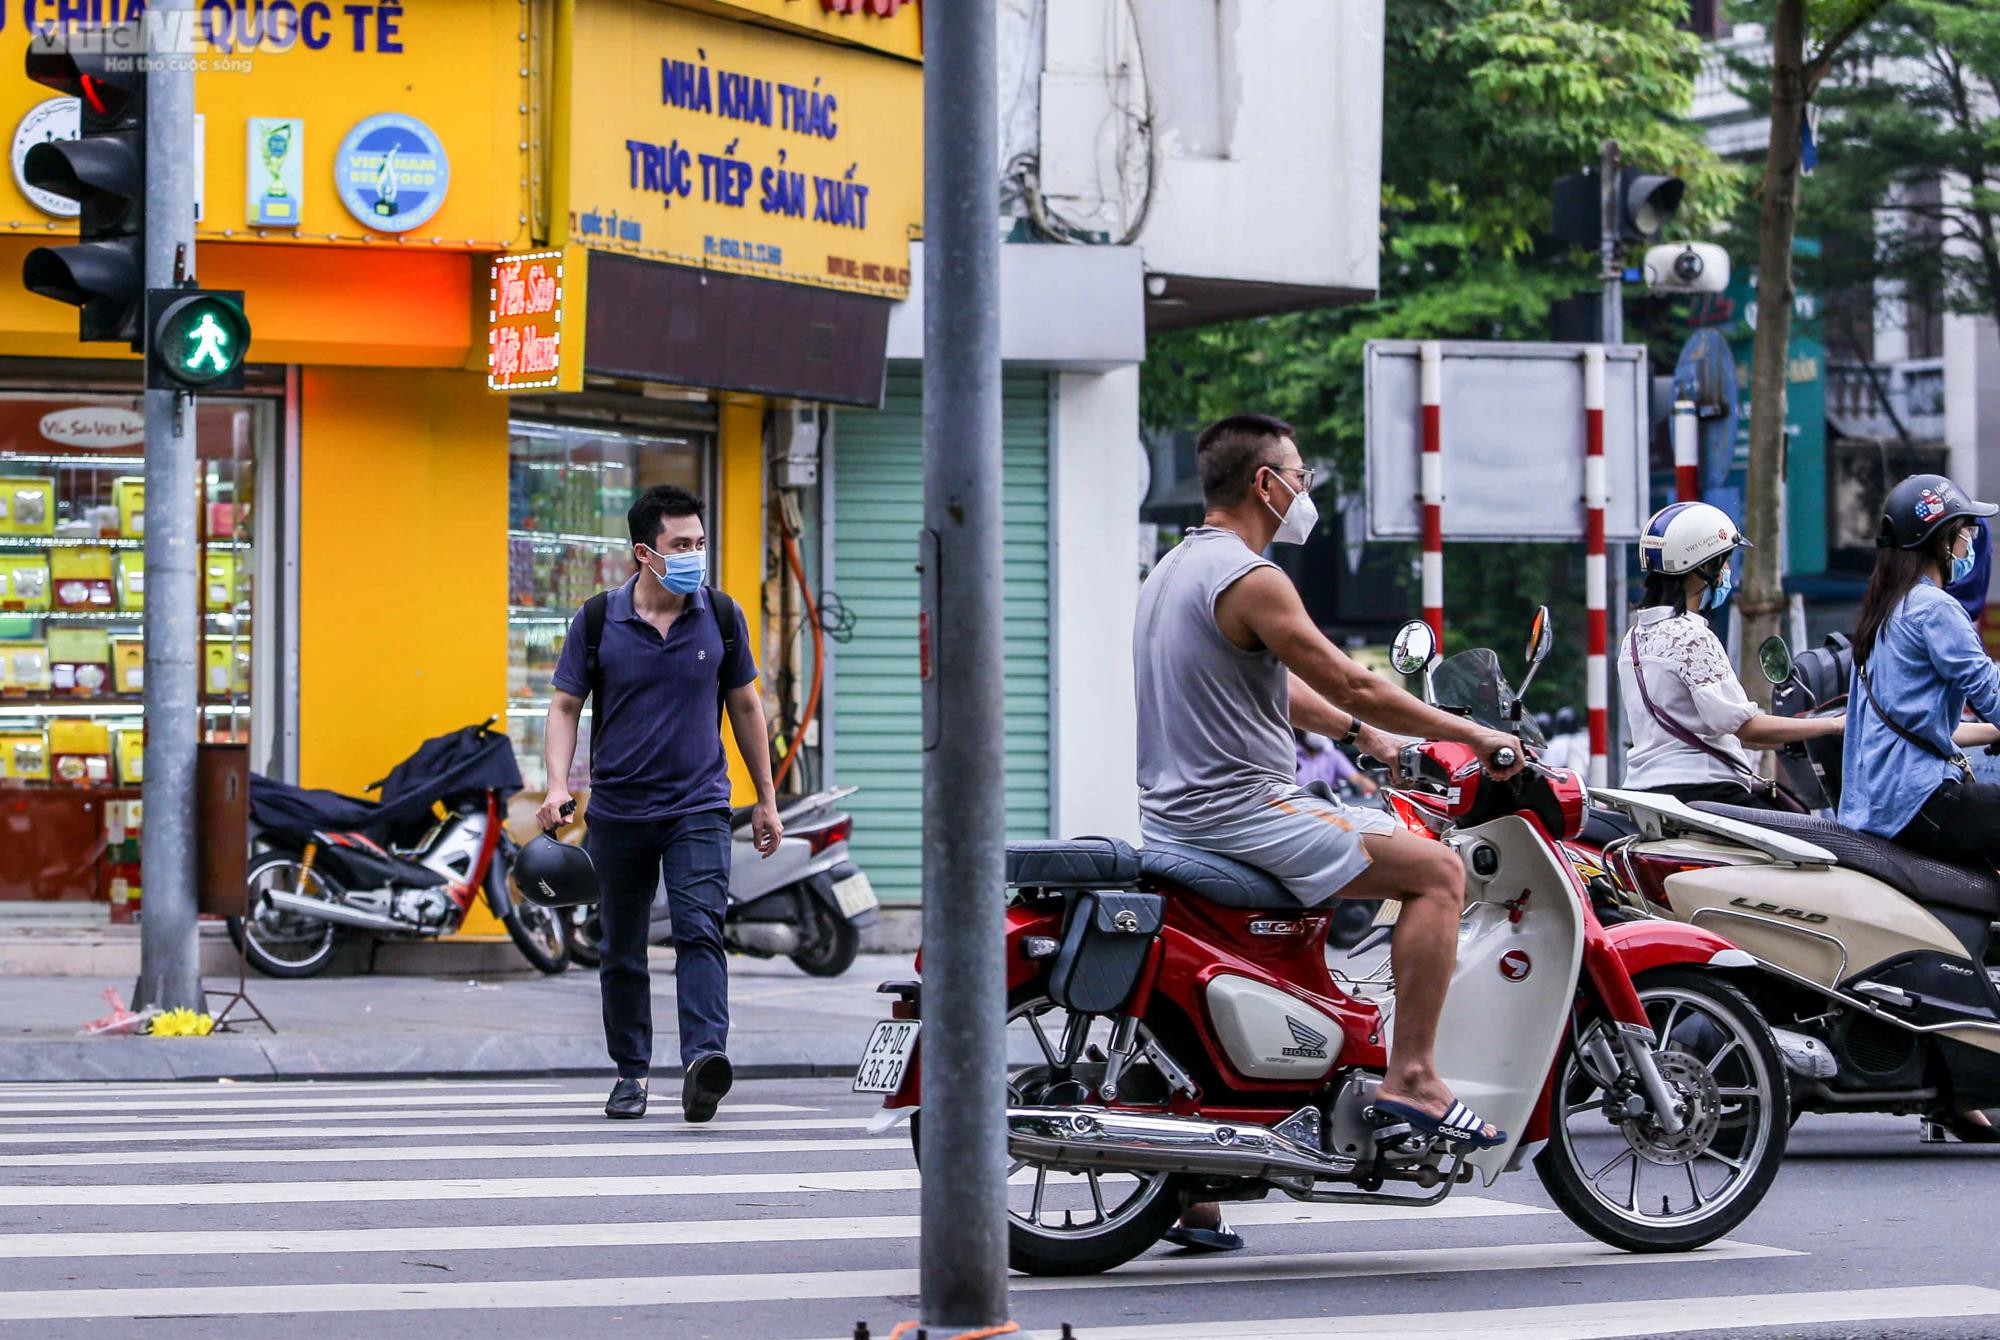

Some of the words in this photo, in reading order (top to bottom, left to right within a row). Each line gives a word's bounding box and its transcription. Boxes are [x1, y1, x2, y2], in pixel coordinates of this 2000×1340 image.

[661, 48, 712, 114] NHÀ
[718, 70, 772, 127] KHAI
[778, 77, 837, 140] THÁC
[626, 139, 691, 209] TRỰC
[699, 138, 753, 207] TIẾP
[760, 149, 805, 219] SẢN
[813, 163, 869, 230] XUẤT
[1729, 897, 1829, 924] LEAD
[1282, 1047, 1328, 1059] HONDA
[858, 1059, 903, 1089] 436.28
[1438, 1125, 1472, 1140] adidas
